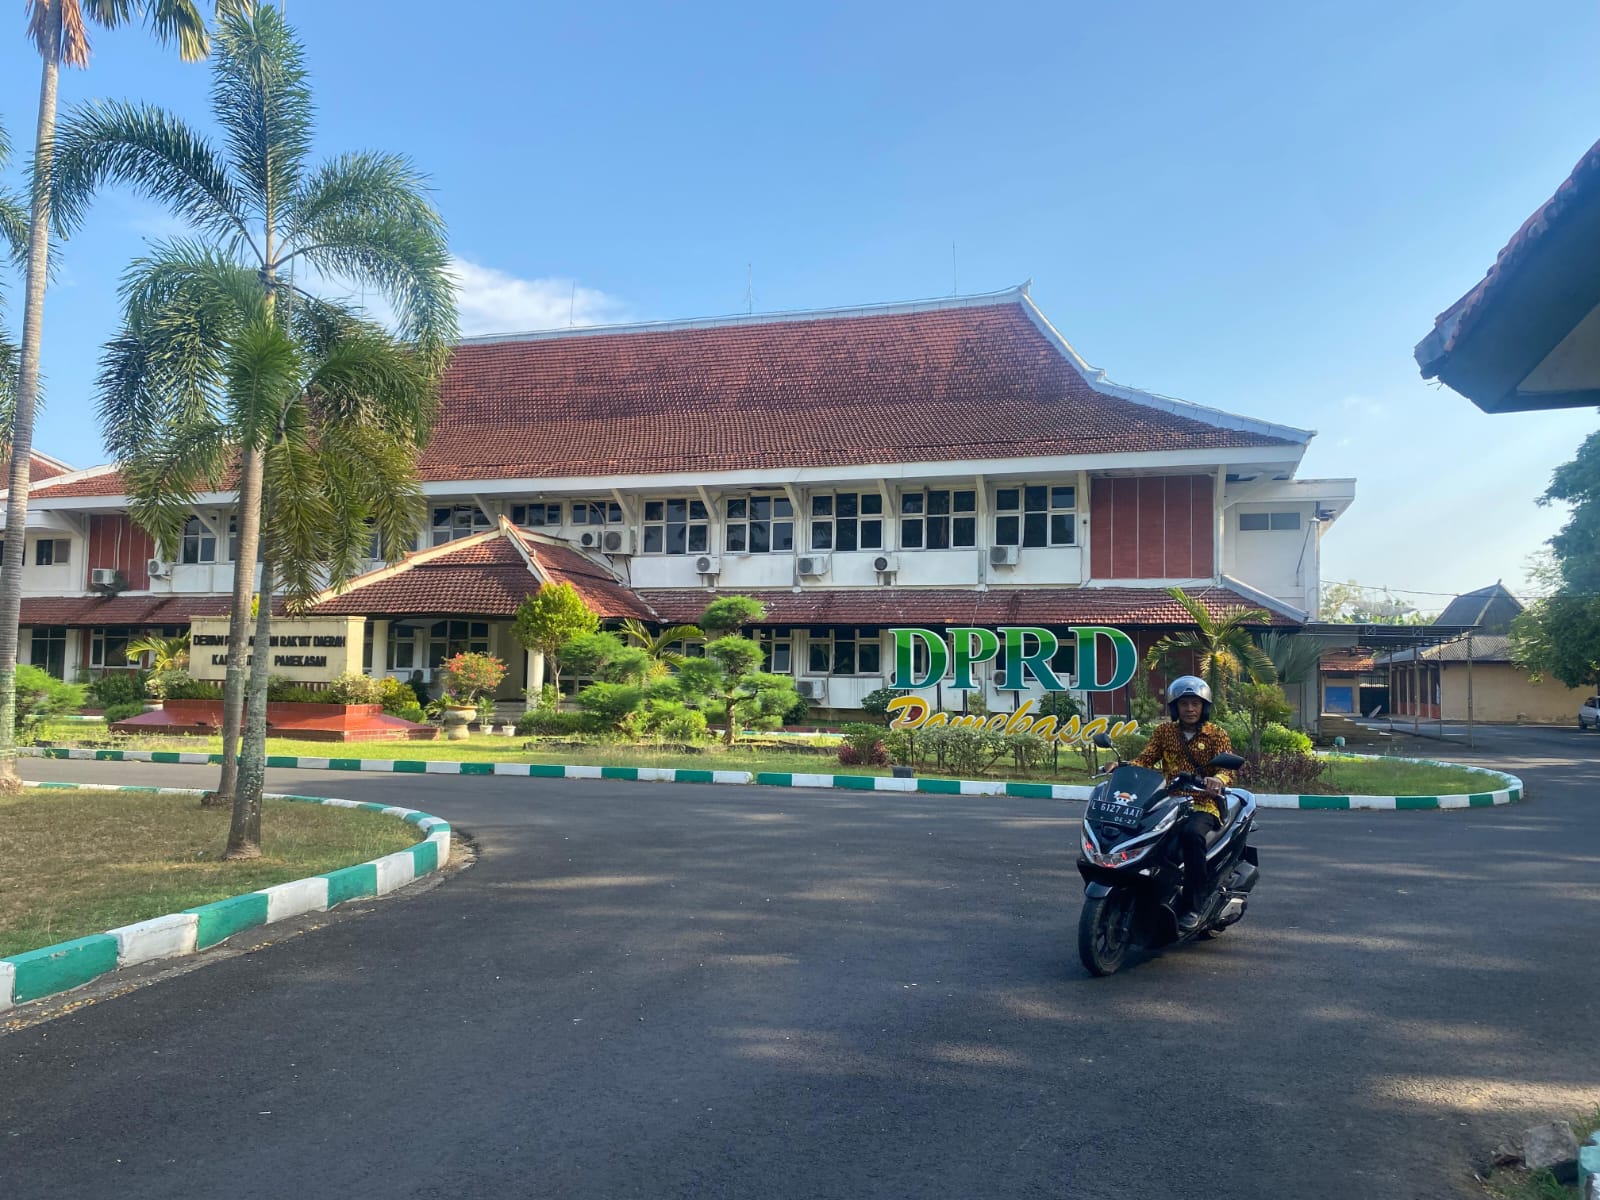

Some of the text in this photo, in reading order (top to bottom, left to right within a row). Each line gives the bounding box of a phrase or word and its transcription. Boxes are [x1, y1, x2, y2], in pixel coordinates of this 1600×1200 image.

[280, 636, 312, 647] RAKYAT
[313, 636, 346, 647] DAERAH
[274, 655, 327, 667] PAMEKASAN
[888, 626, 1138, 692] DPRD
[886, 695, 1140, 744] Pamekasan
